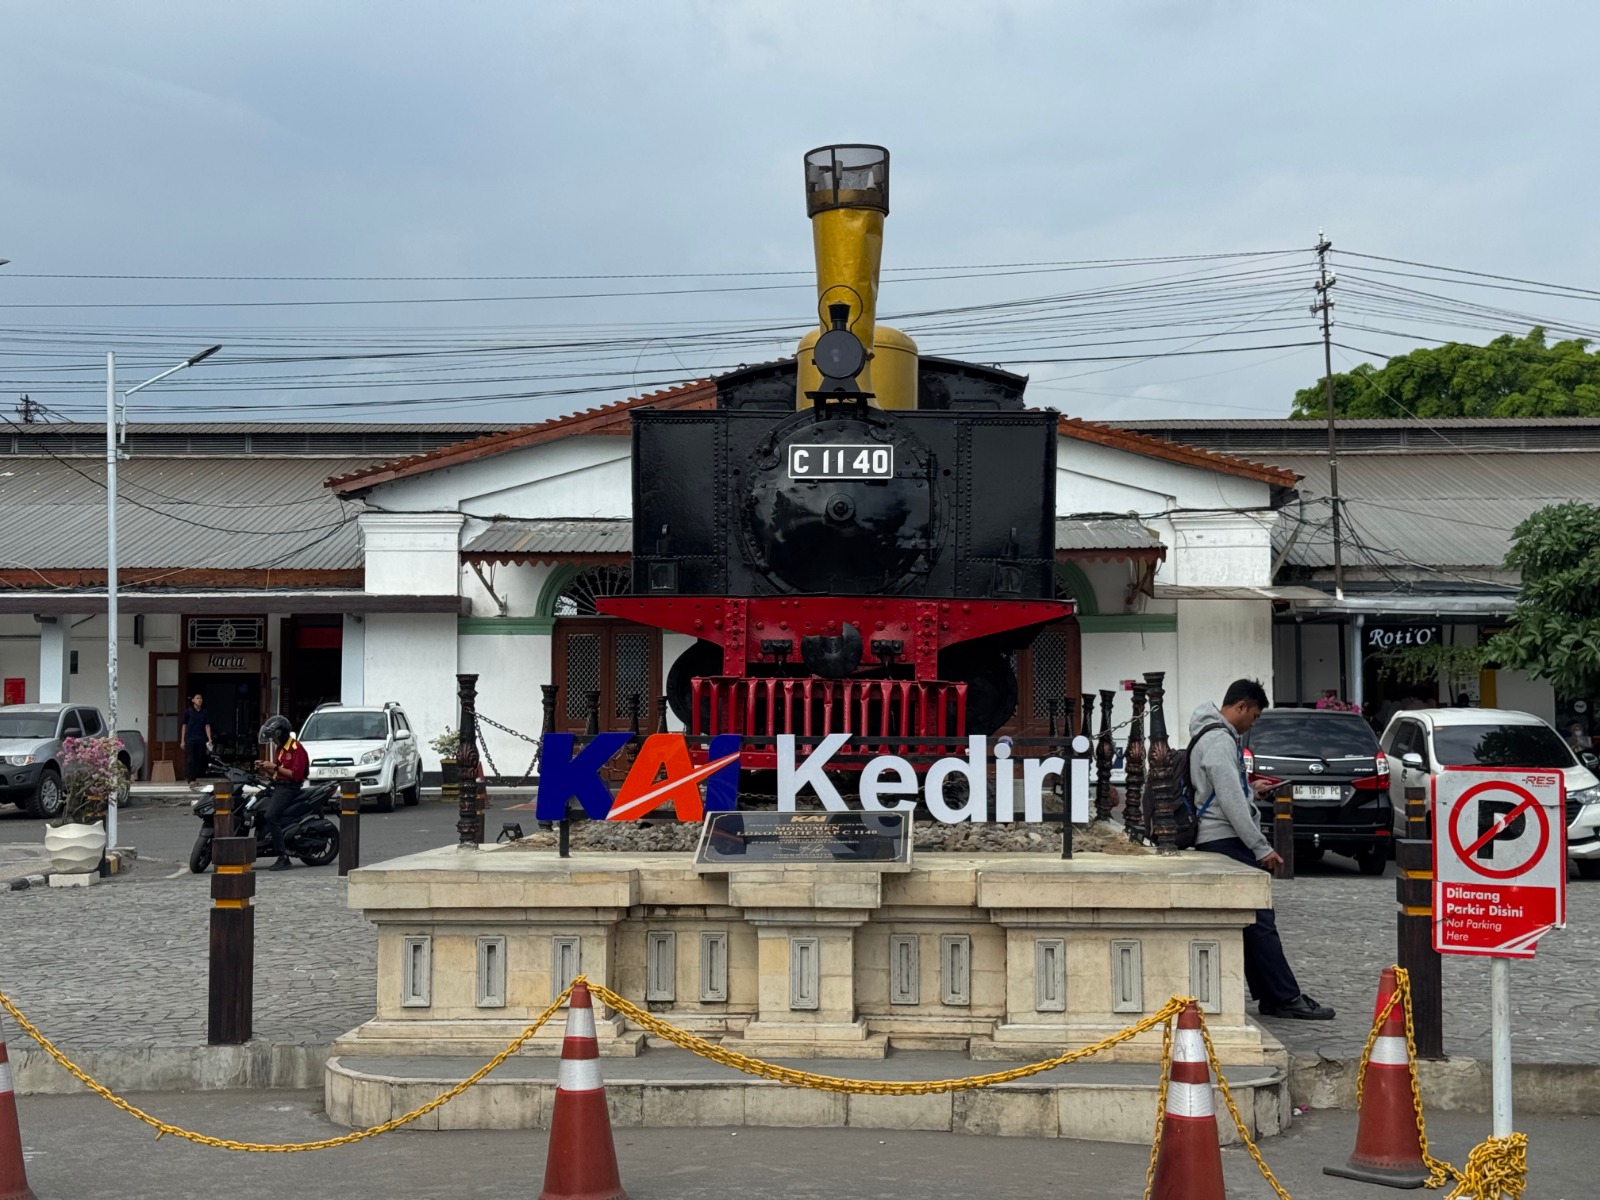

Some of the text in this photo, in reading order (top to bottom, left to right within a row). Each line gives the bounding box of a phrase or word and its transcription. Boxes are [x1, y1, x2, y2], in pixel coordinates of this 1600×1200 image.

[793, 449, 889, 474] C 1140
[536, 732, 1090, 824] KAI Kediri
[1294, 786, 1340, 796] AG 1670 PC
[1446, 887, 1500, 904] Dilarang
[1446, 903, 1523, 918] Parkir Disini
[1446, 918, 1502, 932] Not Parking
[1446, 930, 1469, 941] Here
